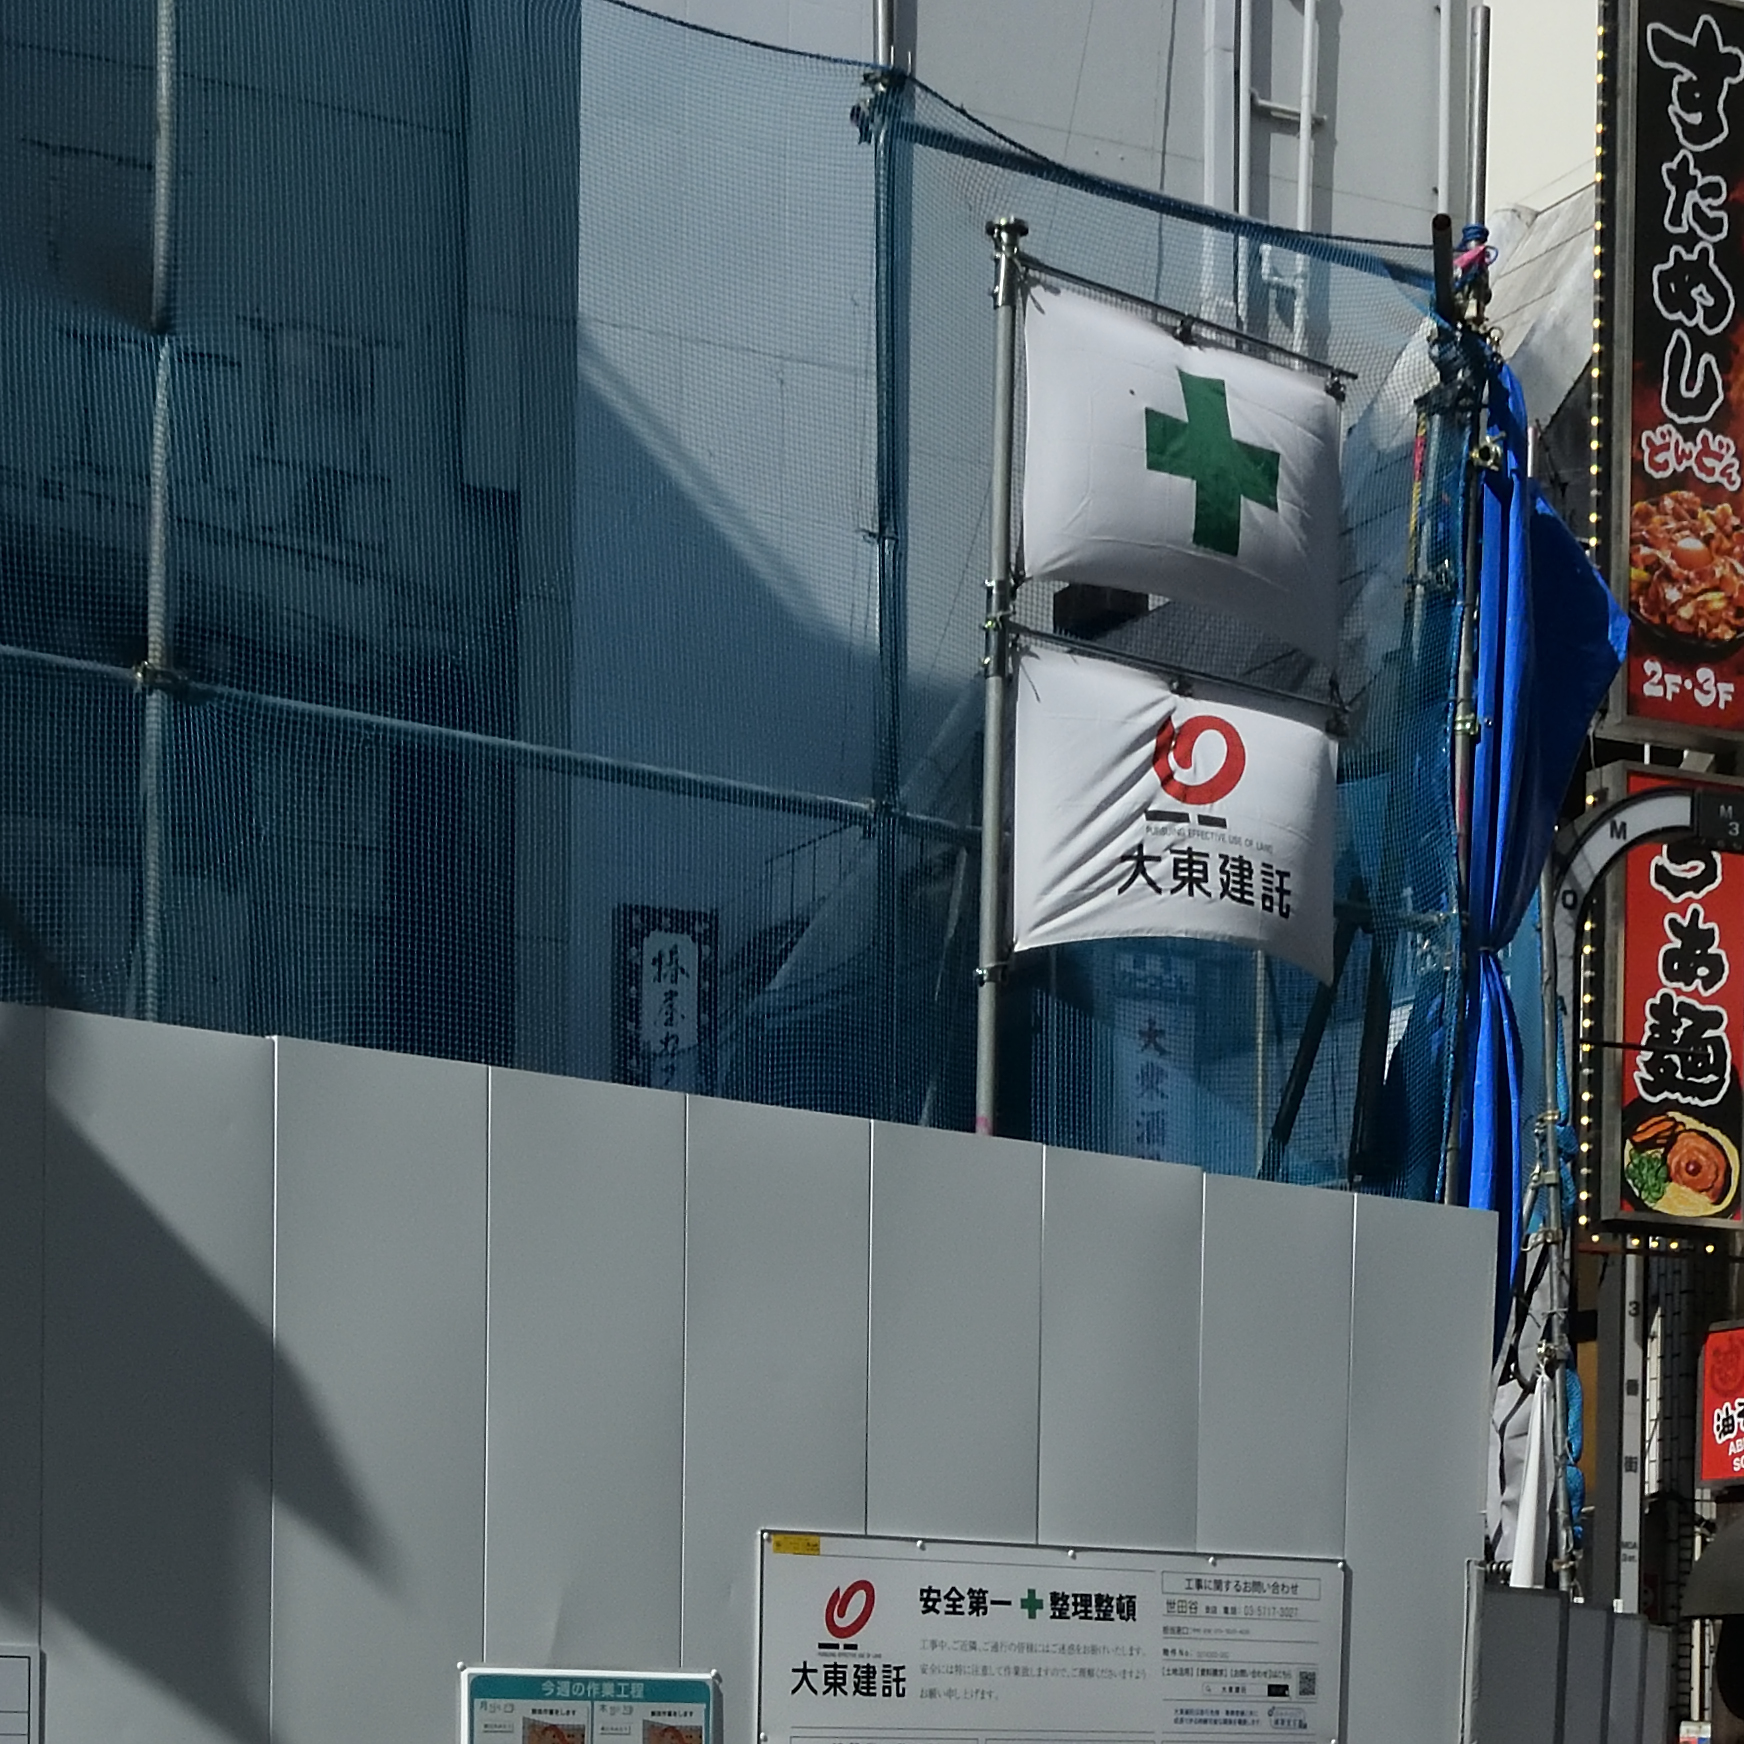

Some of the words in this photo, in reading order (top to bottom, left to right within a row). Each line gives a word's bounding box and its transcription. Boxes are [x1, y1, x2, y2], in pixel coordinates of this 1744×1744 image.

[1117, 841, 1293, 922] 大東建託
[1184, 1577, 1300, 1596] 工事に関するお問い合わせ
[919, 1584, 1014, 1618] 安全第一
[1048, 1590, 1138, 1623] 整理整頓
[1166, 1599, 1199, 1615] 世田谷
[541, 1679, 645, 1699] 今週の作業工程
[790, 1660, 908, 1698] 大東建託
